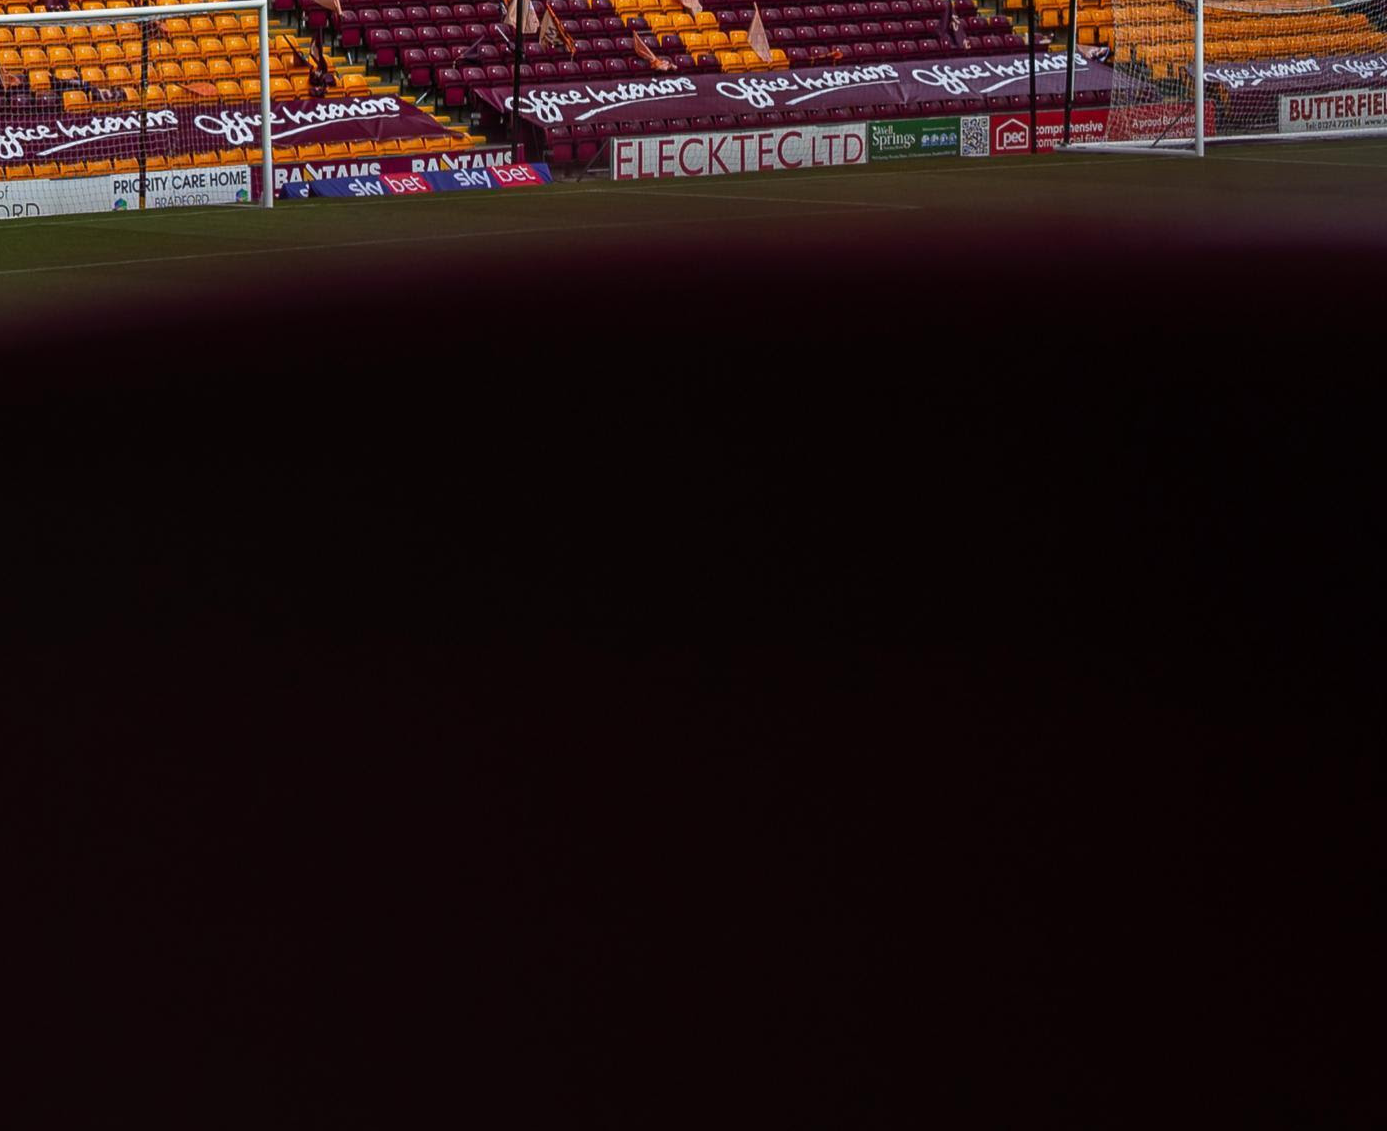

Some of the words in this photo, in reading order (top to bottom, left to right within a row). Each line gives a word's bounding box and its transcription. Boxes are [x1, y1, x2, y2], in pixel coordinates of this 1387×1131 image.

[716, 77, 798, 109] Office
[793, 64, 899, 92] Interiors
[912, 64, 990, 95] Office
[283, 96, 400, 127] Interiors
[505, 88, 590, 124] Office
[585, 77, 696, 104] Interiors
[1003, 128, 1025, 144] pec
[1036, 121, 1103, 135] comprhensive
[872, 133, 916, 150] Springs
[616, 131, 803, 180] ELECKTEC
[811, 133, 864, 166] LTD
[172, 173, 206, 190] CARE
[210, 170, 248, 186] HOME
[348, 178, 384, 197] sky
[384, 173, 427, 193] bet
[454, 169, 491, 189] sky
[491, 165, 536, 183] bet
